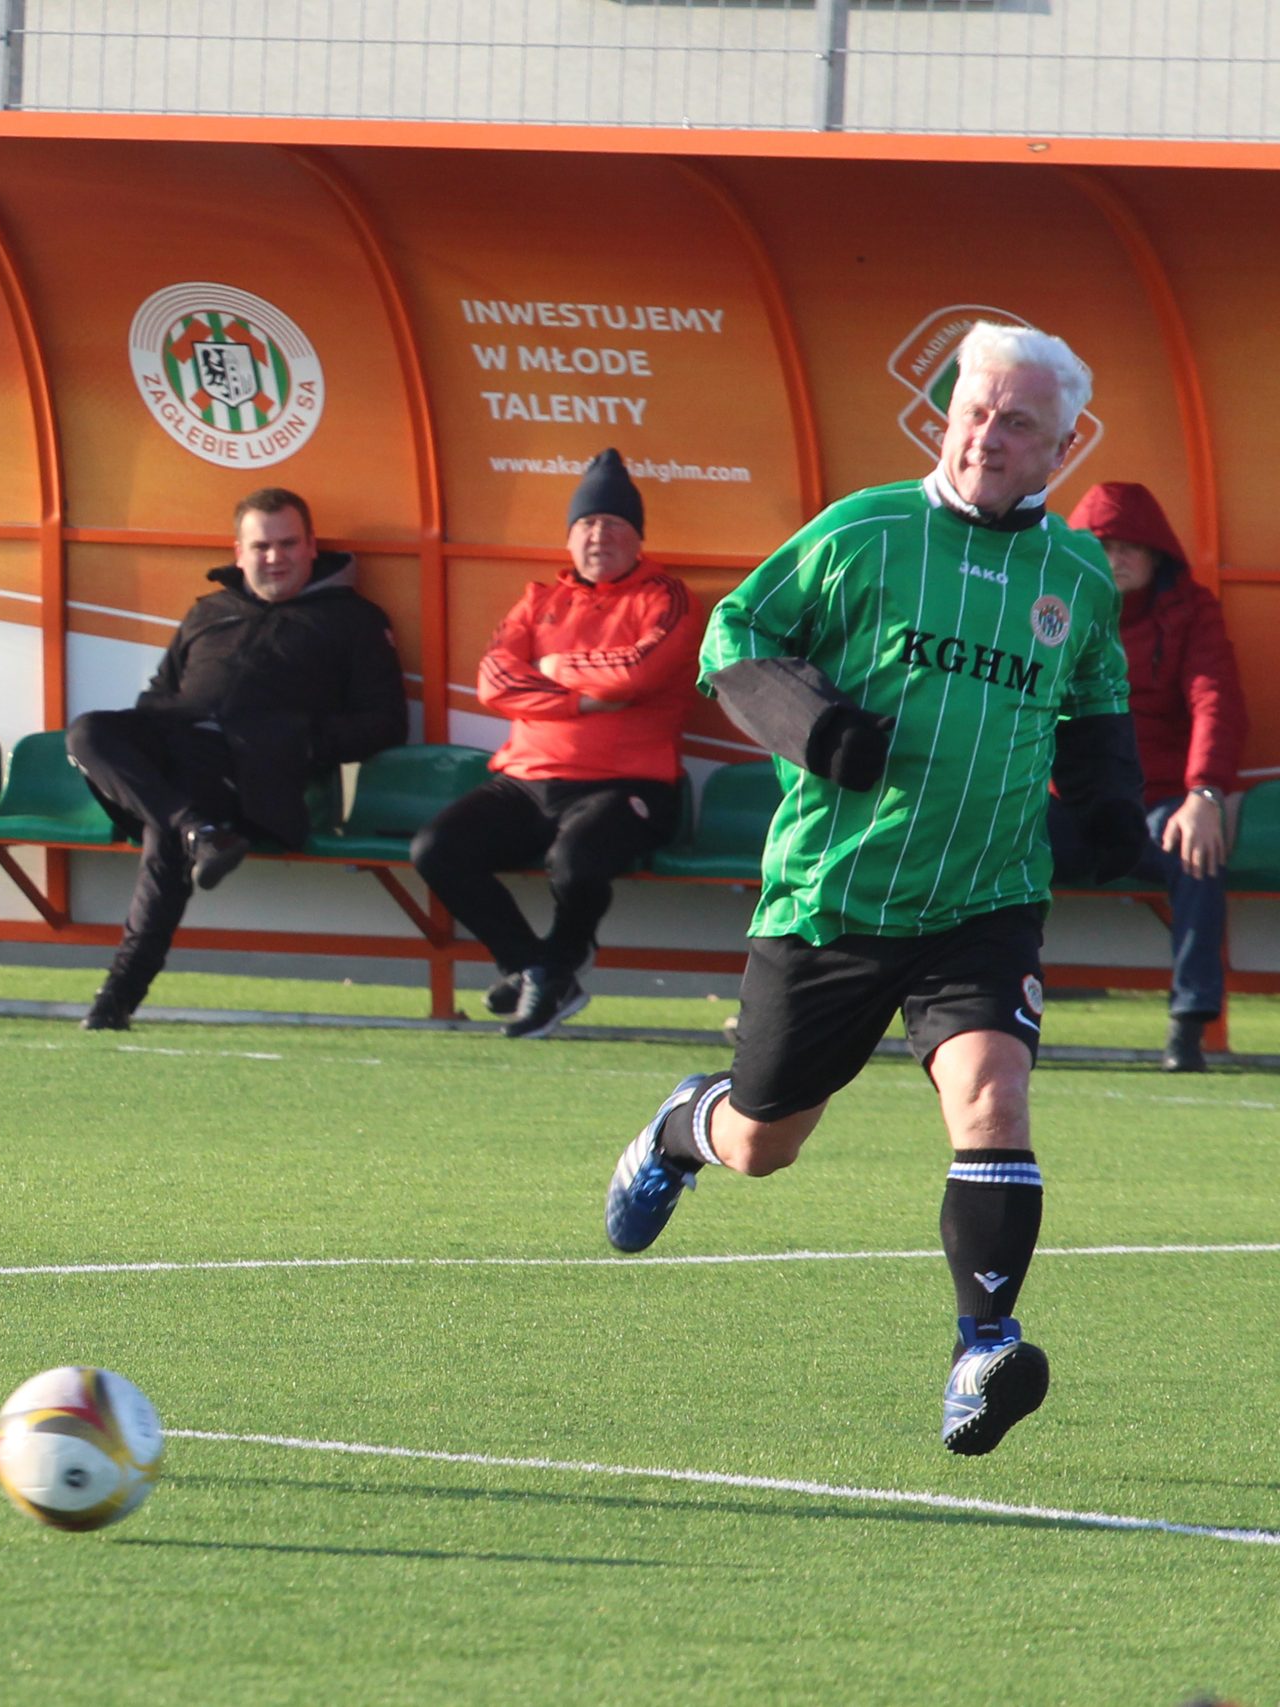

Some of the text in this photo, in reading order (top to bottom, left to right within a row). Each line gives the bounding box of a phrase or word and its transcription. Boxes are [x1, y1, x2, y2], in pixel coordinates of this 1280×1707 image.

[461, 299, 724, 333] INWESTUJEMY
[472, 343, 652, 376] W MŁODE
[142, 372, 317, 460] ZAGŁĘBIE LUBIN SA
[481, 391, 647, 425] TALENTY
[490, 455, 750, 482] www.akadiakghm.com
[959, 560, 1009, 585] JAKO
[896, 628, 1045, 697] KGHM
